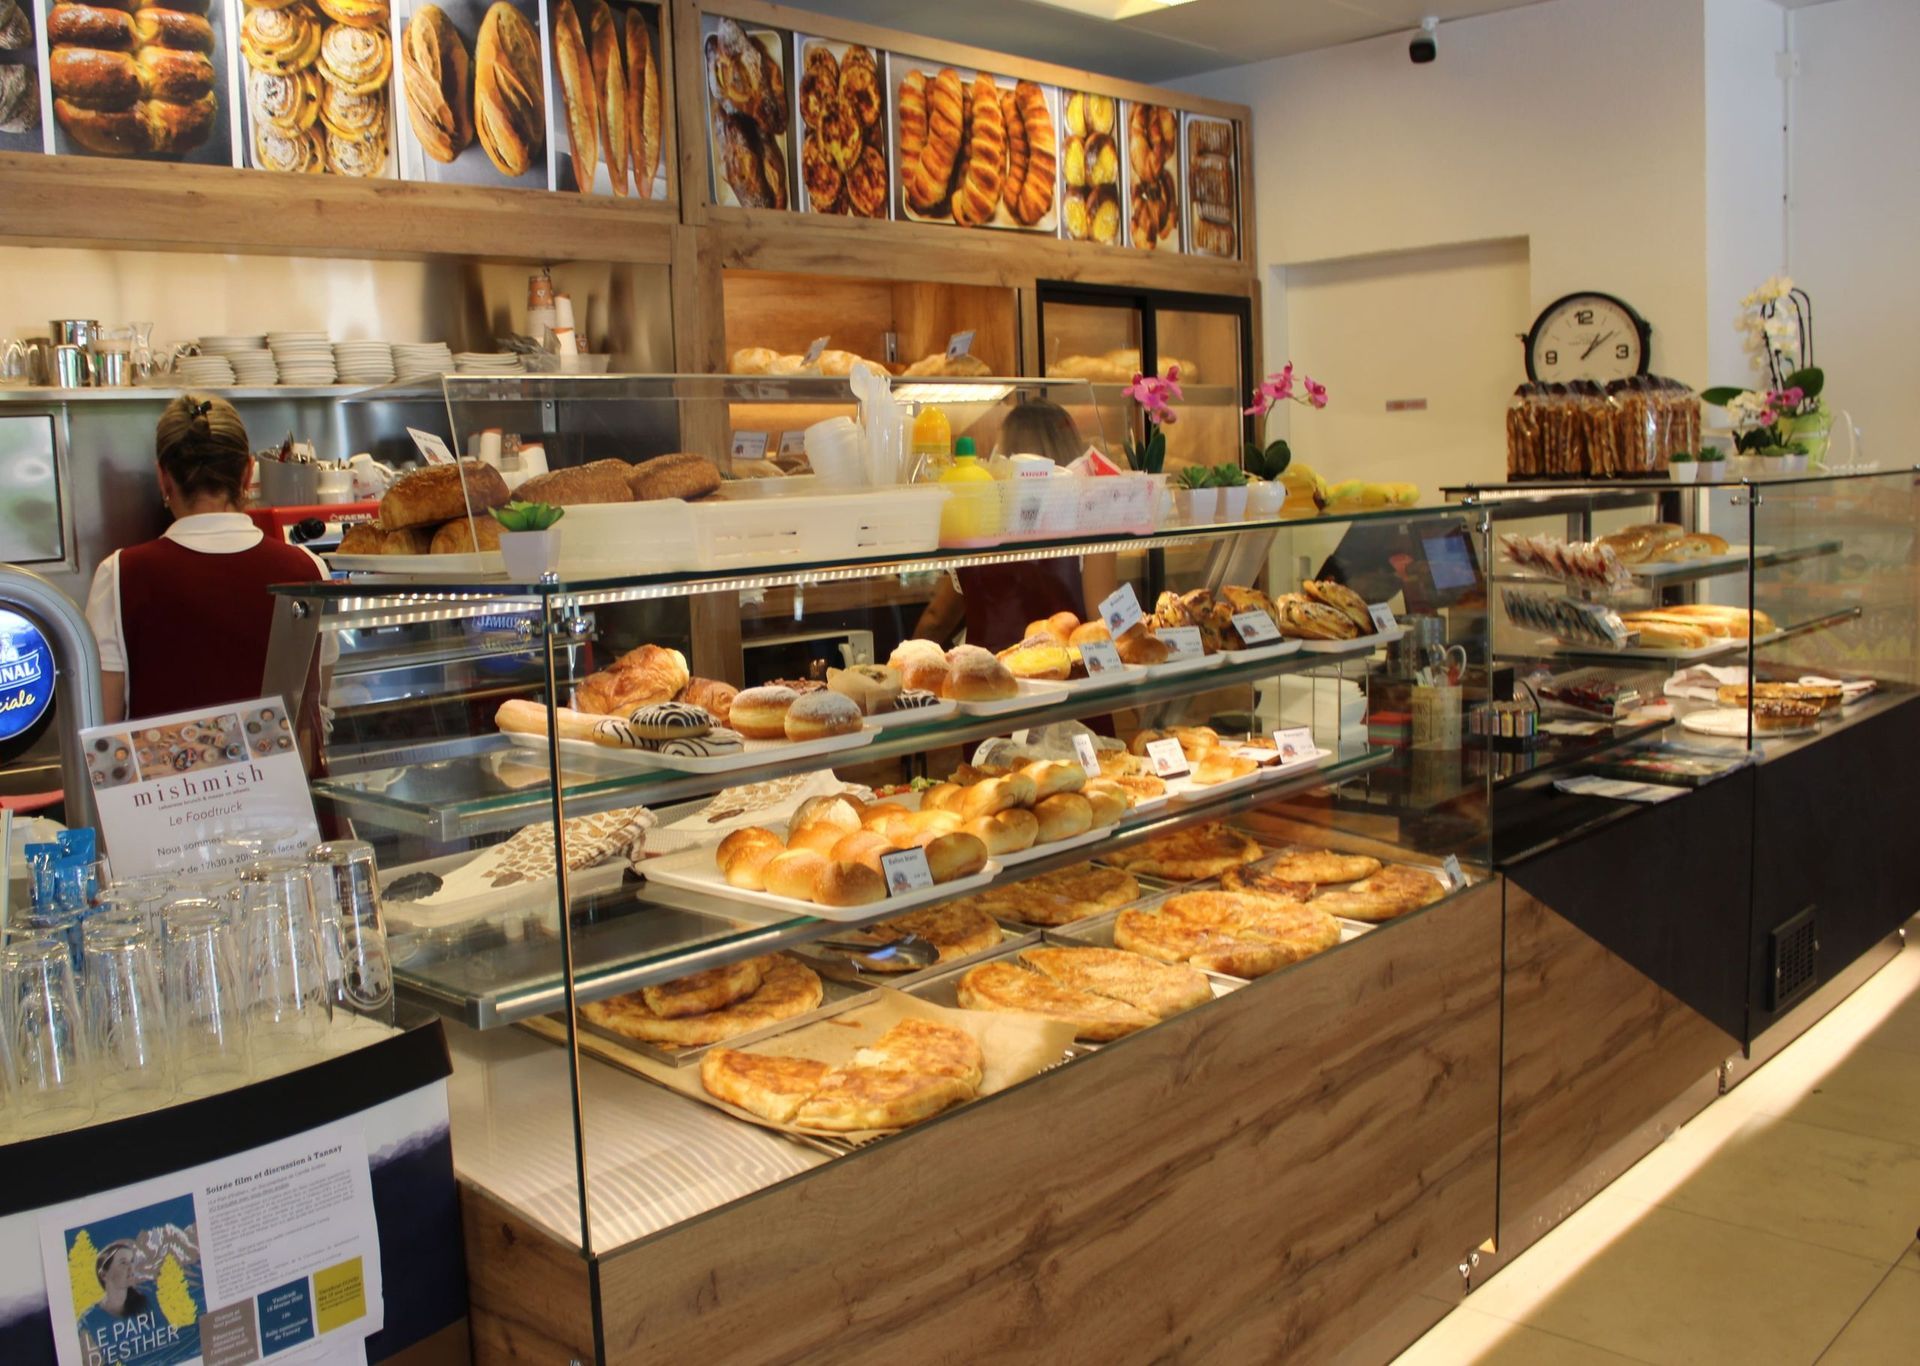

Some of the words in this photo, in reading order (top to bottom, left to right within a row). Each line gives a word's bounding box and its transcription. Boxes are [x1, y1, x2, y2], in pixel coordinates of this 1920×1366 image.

[1574, 310, 1594, 325] 12
[1616, 344, 1629, 360] 3
[338, 512, 373, 521] FAEMA
[133, 764, 264, 807] mishmish
[169, 815, 183, 827] Le
[186, 801, 243, 823] Foodtruck
[157, 846, 181, 857] Nous
[184, 837, 221, 851] sommes
[187, 865, 199, 874] de
[201, 858, 227, 872] 17h30
[205, 1181, 233, 1195] Soirée
[234, 1172, 253, 1187] film
[254, 1168, 263, 1180] et
[263, 1157, 306, 1177] discussion
[313, 1145, 343, 1160] Tannay
[85, 1327, 110, 1351] LE
[112, 1311, 157, 1342] PARI
[88, 1324, 180, 1366] D'ESTHER
